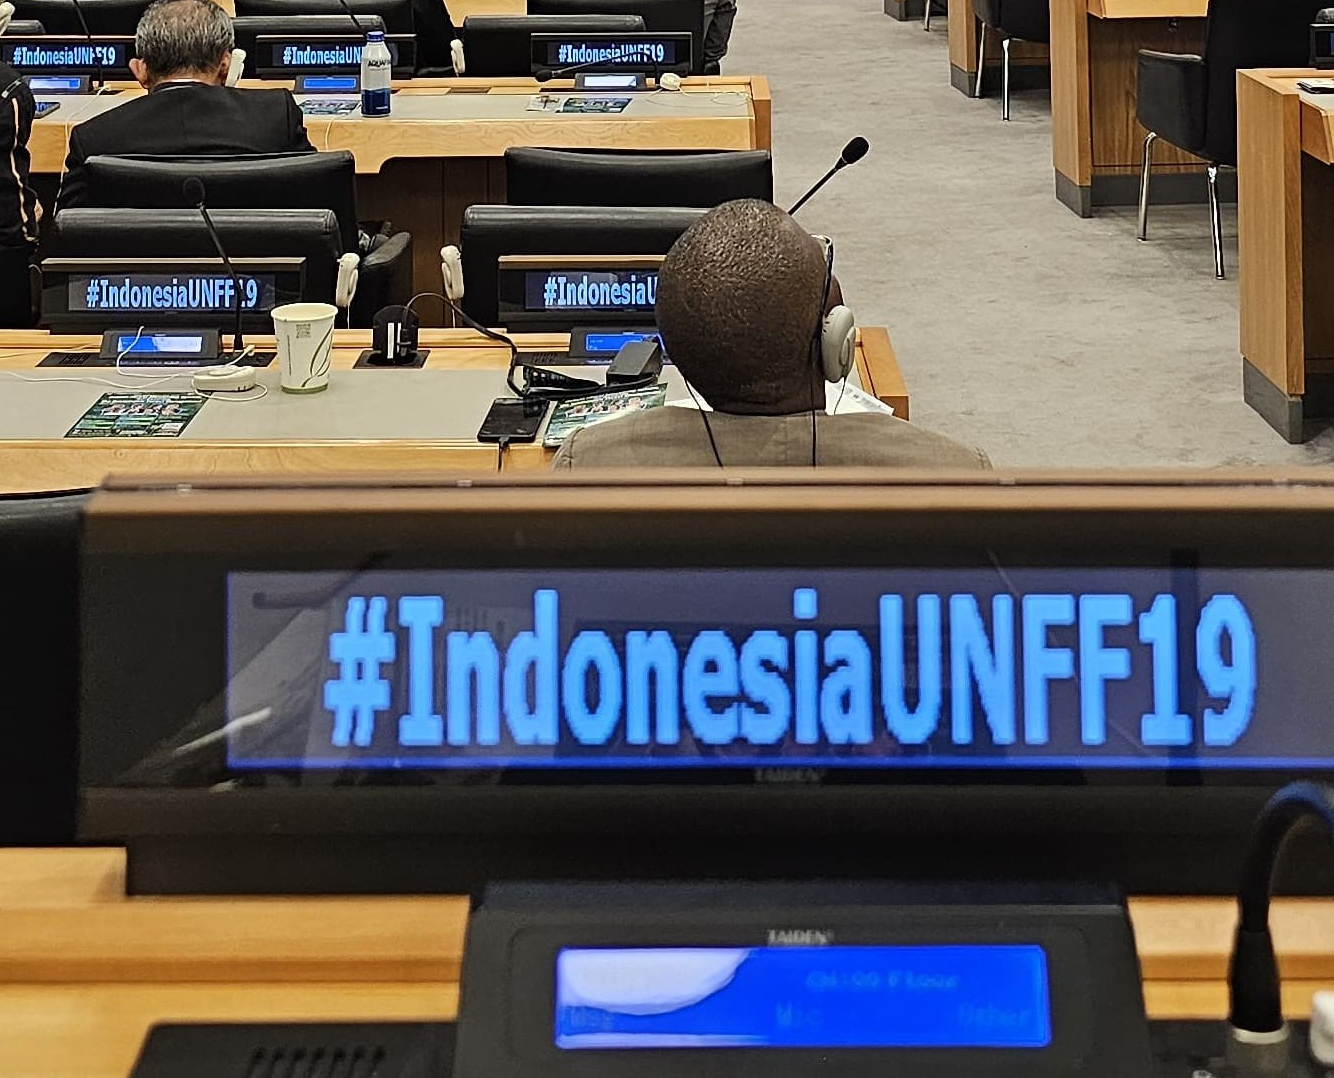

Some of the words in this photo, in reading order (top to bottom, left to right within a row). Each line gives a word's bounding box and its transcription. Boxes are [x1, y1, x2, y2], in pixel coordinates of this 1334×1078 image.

[283, 46, 365, 65] #IndonesiaUN
[544, 275, 658, 307] #IndonesiaU
[323, 588, 1258, 748] #IndonesiaUNFF19
